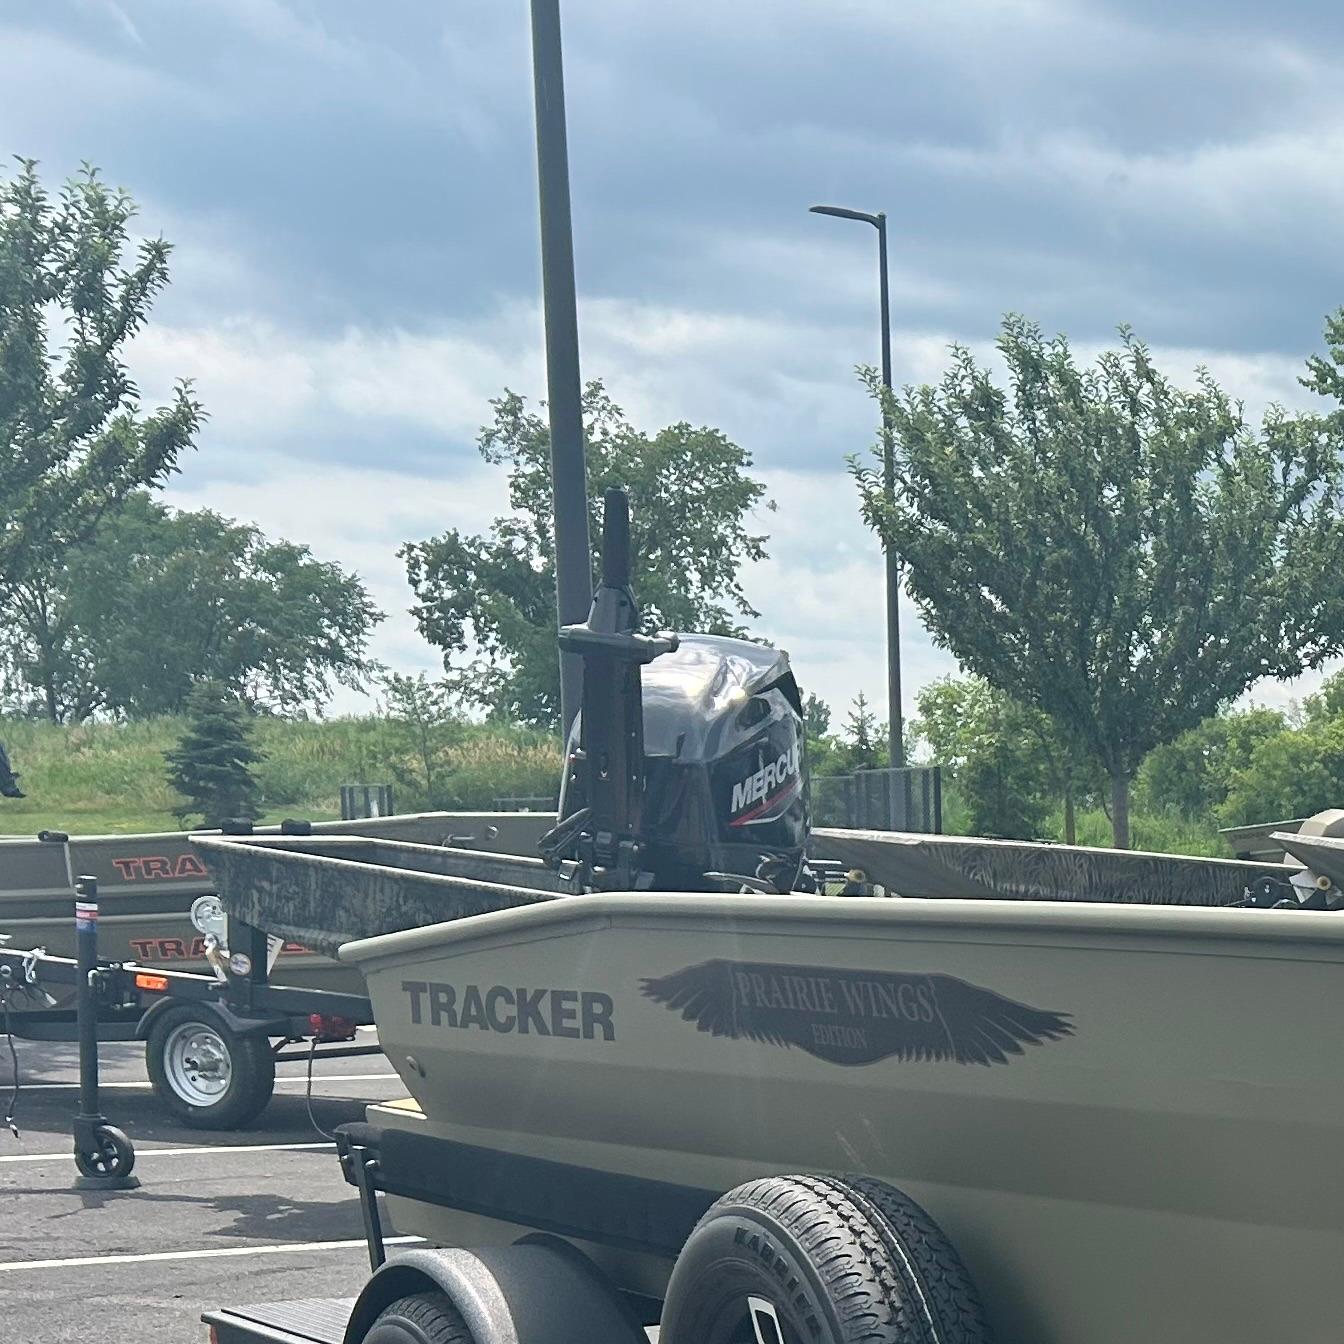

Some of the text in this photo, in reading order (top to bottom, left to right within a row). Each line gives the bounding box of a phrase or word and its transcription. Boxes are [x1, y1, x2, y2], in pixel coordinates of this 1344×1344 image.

[401, 980, 616, 1041] TRACKER
[737, 972, 934, 1023] PRAIRIE WINGS
[811, 1023, 867, 1048] EDITION
